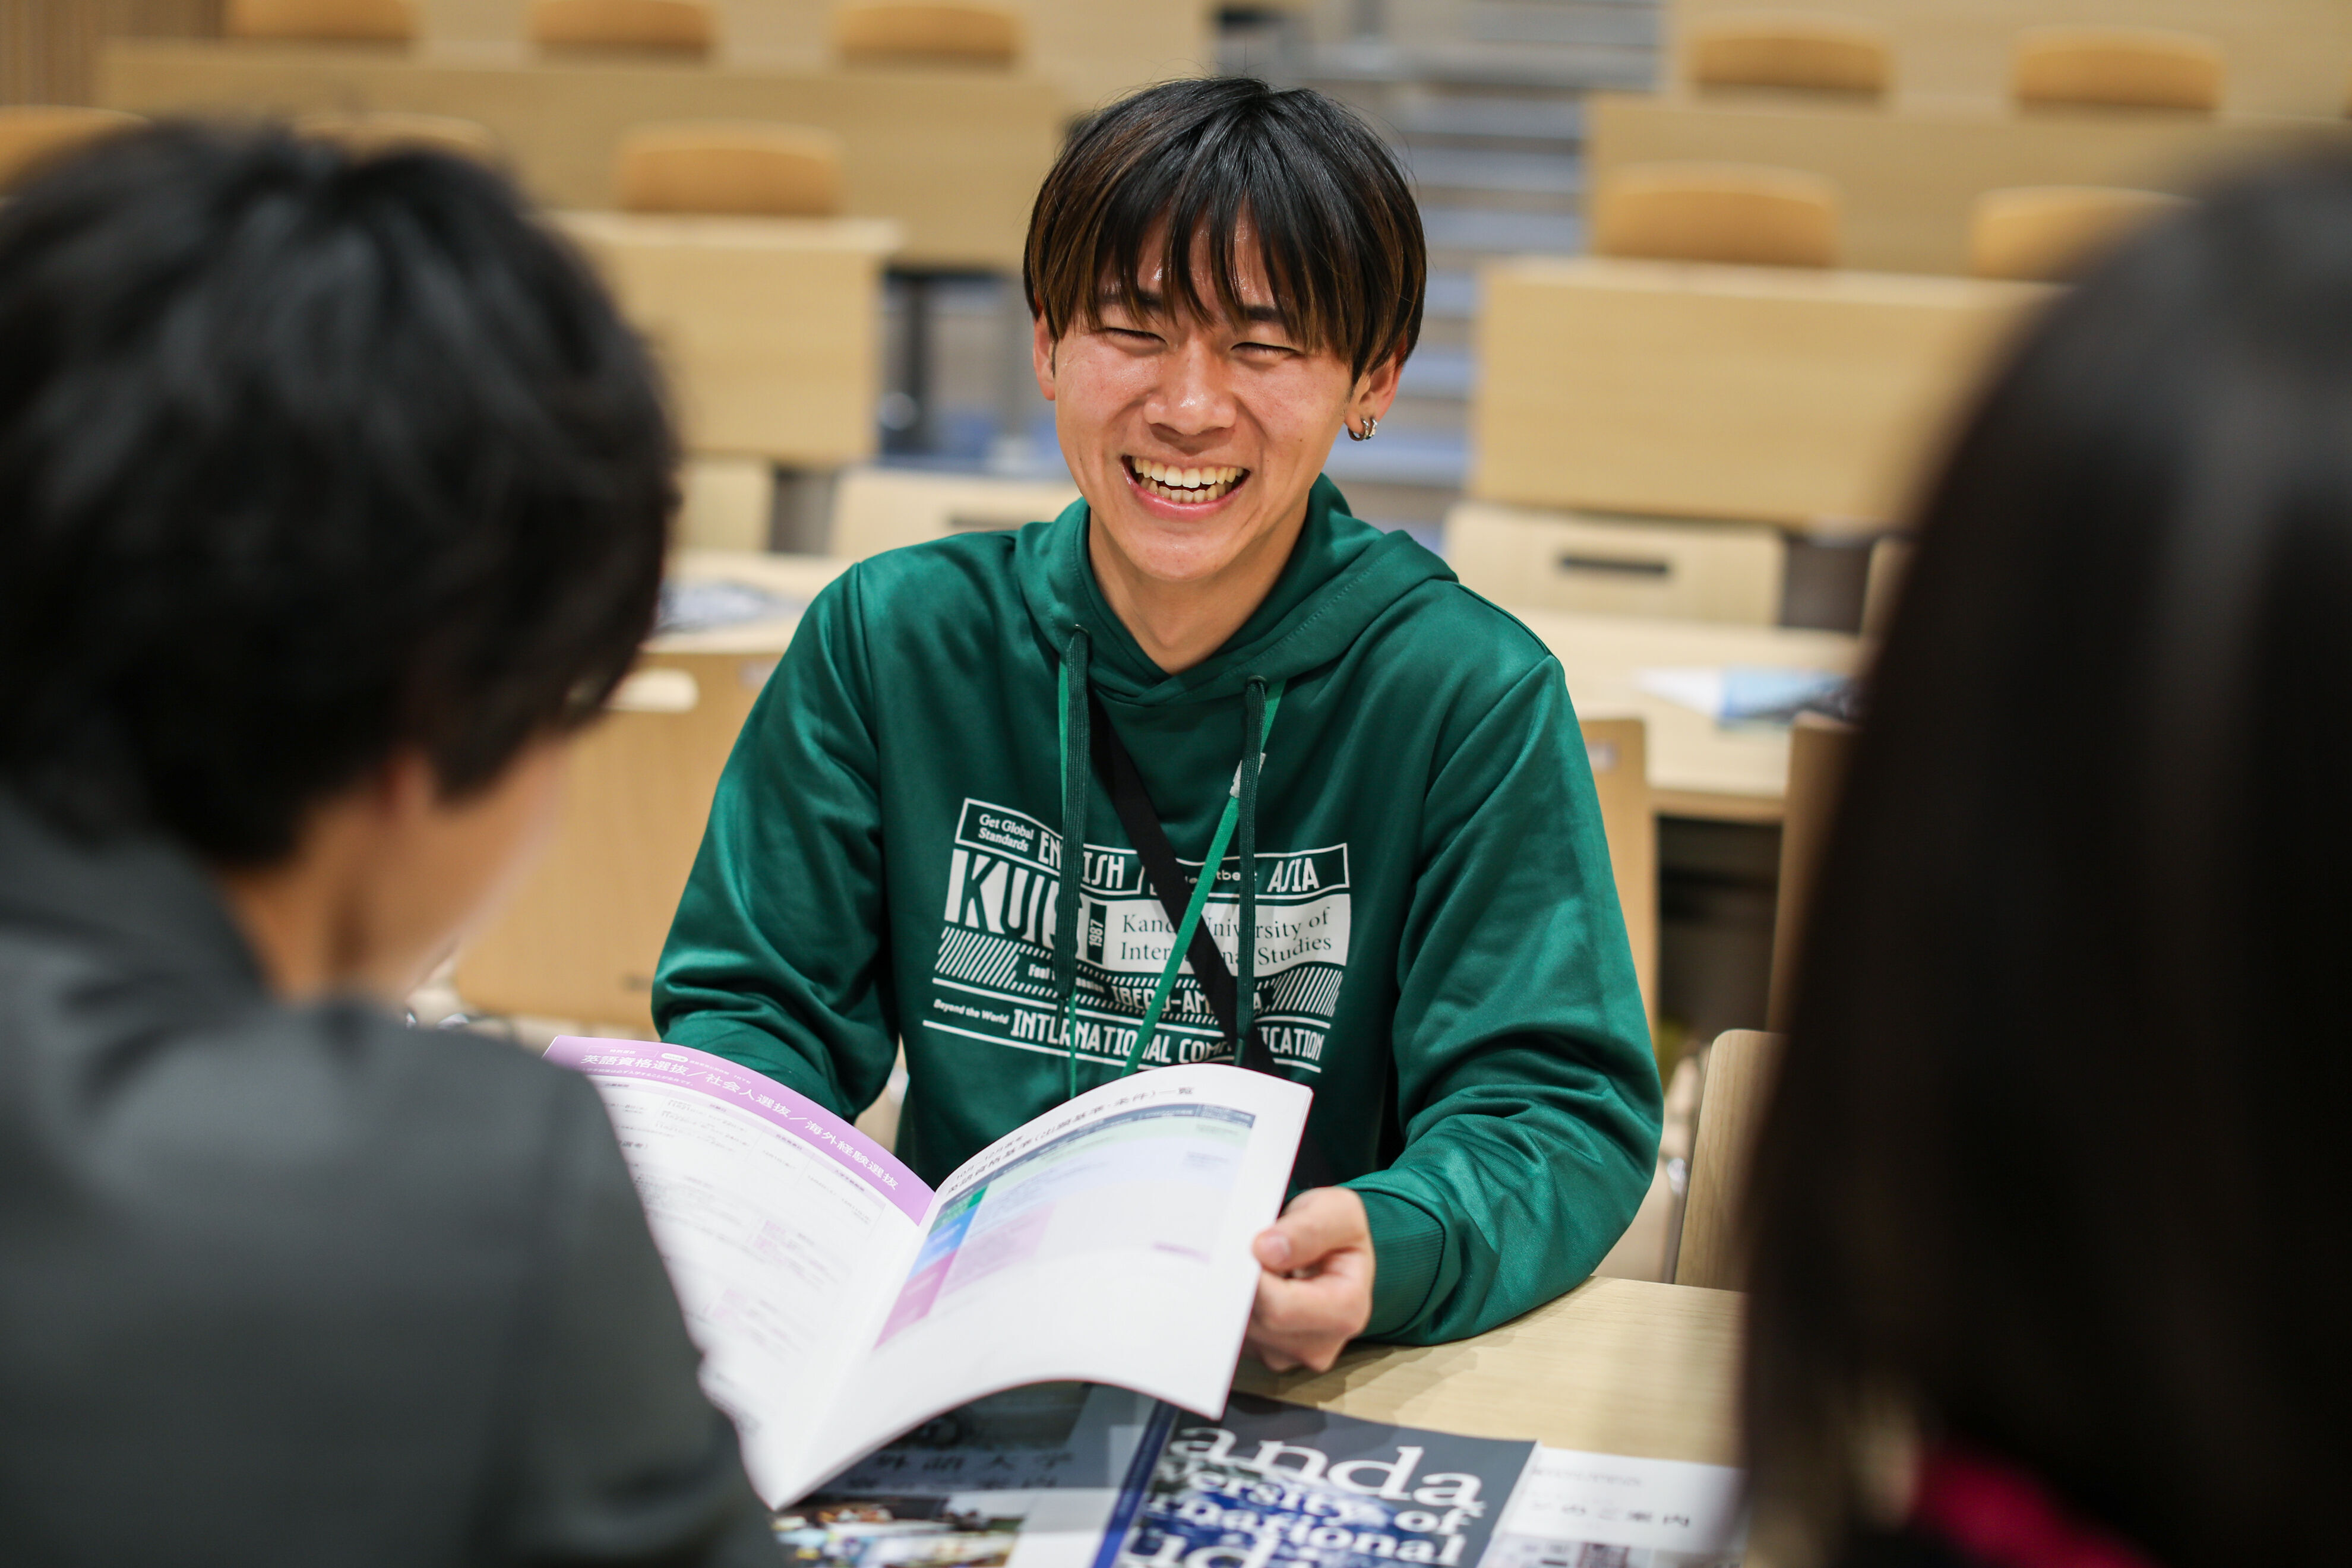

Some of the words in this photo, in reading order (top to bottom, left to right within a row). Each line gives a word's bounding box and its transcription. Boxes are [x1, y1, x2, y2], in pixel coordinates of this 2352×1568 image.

[978, 827, 1029, 852] Standards
[979, 814, 1000, 829] Get
[1001, 820, 1034, 840] Global
[1038, 831, 1125, 889] ENISH
[1266, 857, 1320, 893] ASIA
[1308, 906, 1330, 928] of
[1088, 919, 1104, 947] 1987
[1257, 937, 1332, 965] Studies
[933, 998, 966, 1014] Beyond
[966, 1006, 981, 1018] the
[981, 1010, 1010, 1025] World
[1394, 1507, 1482, 1535] of
